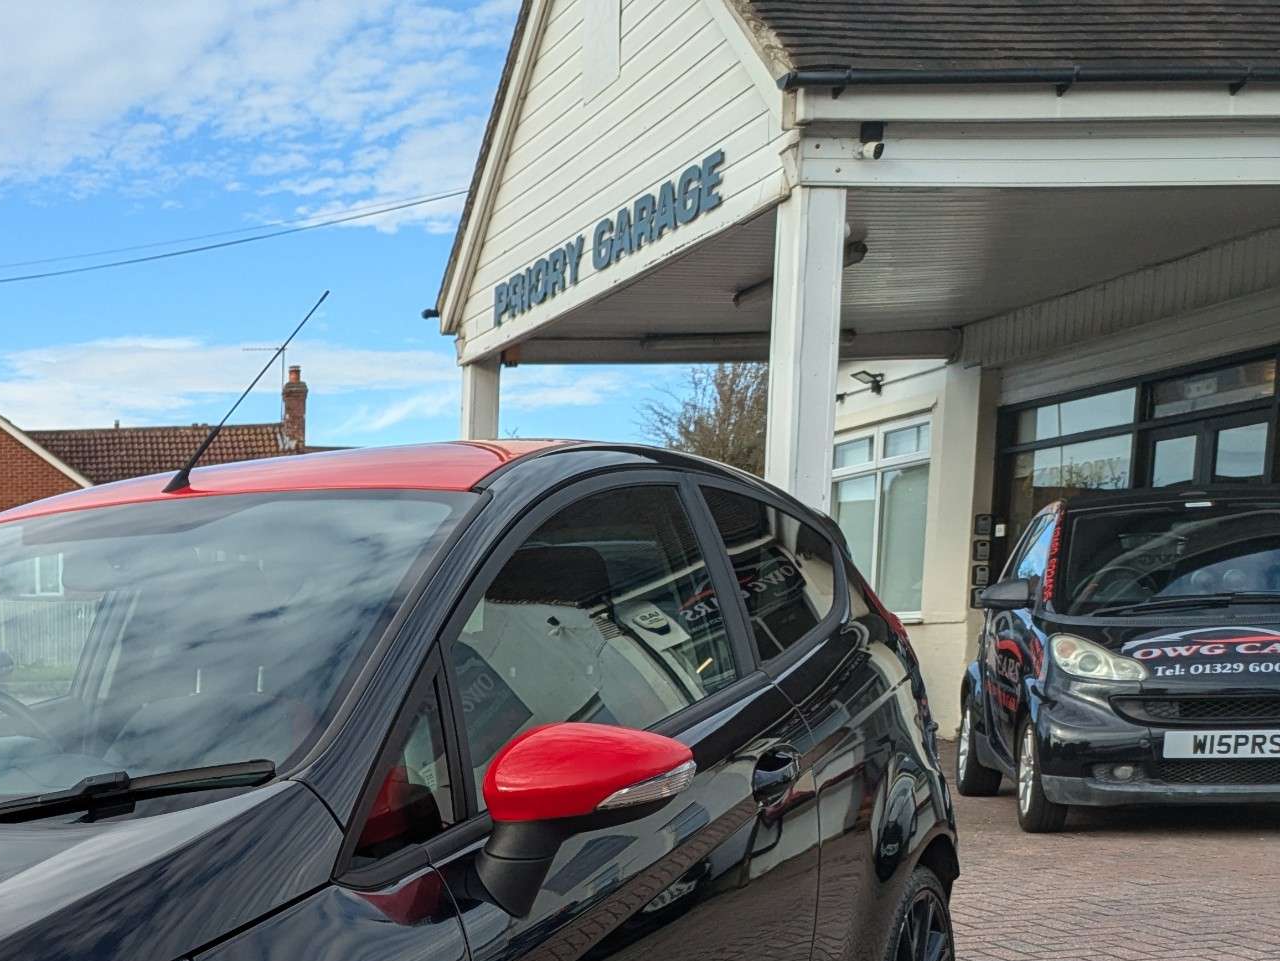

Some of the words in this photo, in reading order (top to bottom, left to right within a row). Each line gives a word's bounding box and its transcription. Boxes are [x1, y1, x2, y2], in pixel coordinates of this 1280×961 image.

[494, 233, 584, 328] PRIORY
[592, 148, 725, 271] GARAGE
[1133, 643, 1227, 659] OWG
[1154, 664, 1185, 677] Tel:
[1189, 662, 1245, 675] 01329
